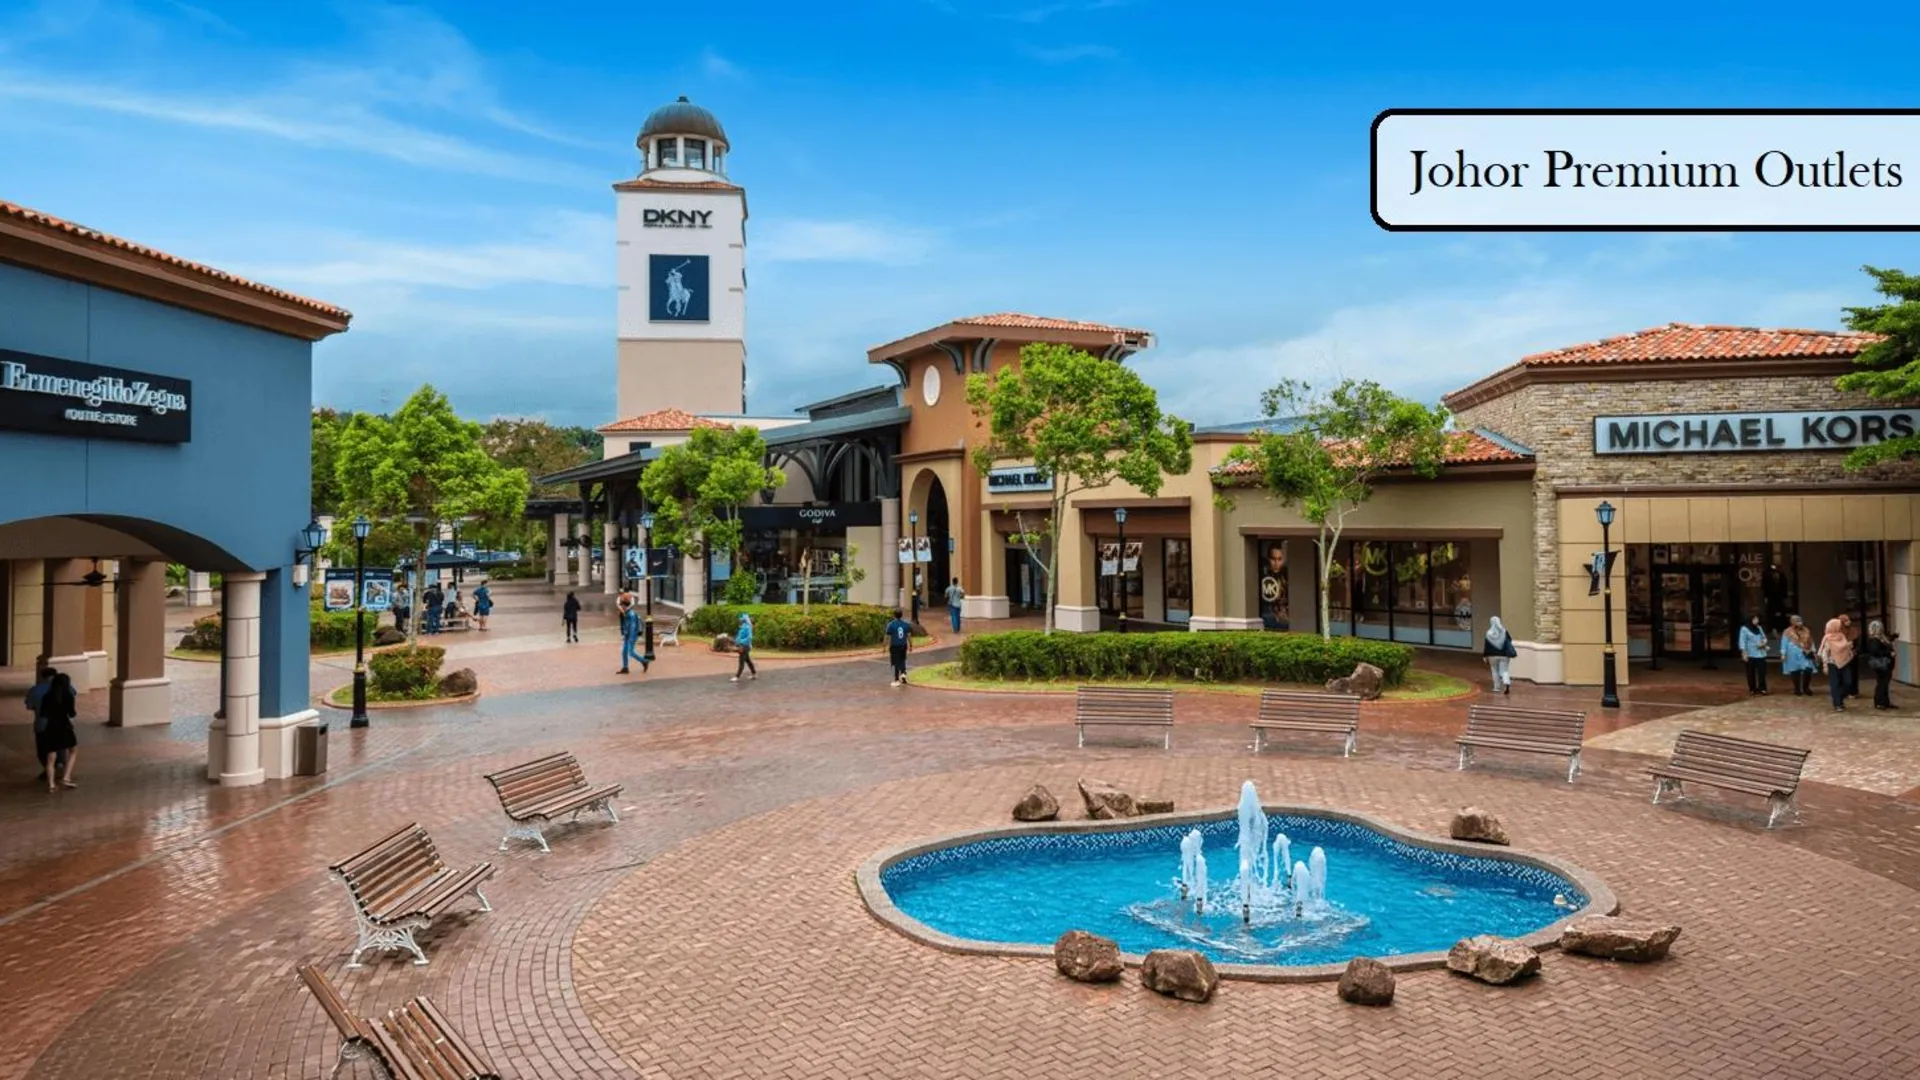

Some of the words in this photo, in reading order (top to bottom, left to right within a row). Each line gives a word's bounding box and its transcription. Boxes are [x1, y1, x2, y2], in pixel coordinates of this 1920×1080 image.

[643, 209, 713, 224] DKNY
[0, 361, 133, 407] Ermenegildo
[132, 381, 187, 415] Zegna
[1609, 418, 1786, 448] MICHAEL
[1802, 414, 1915, 443] KORS
[799, 509, 837, 518] GODIVA
